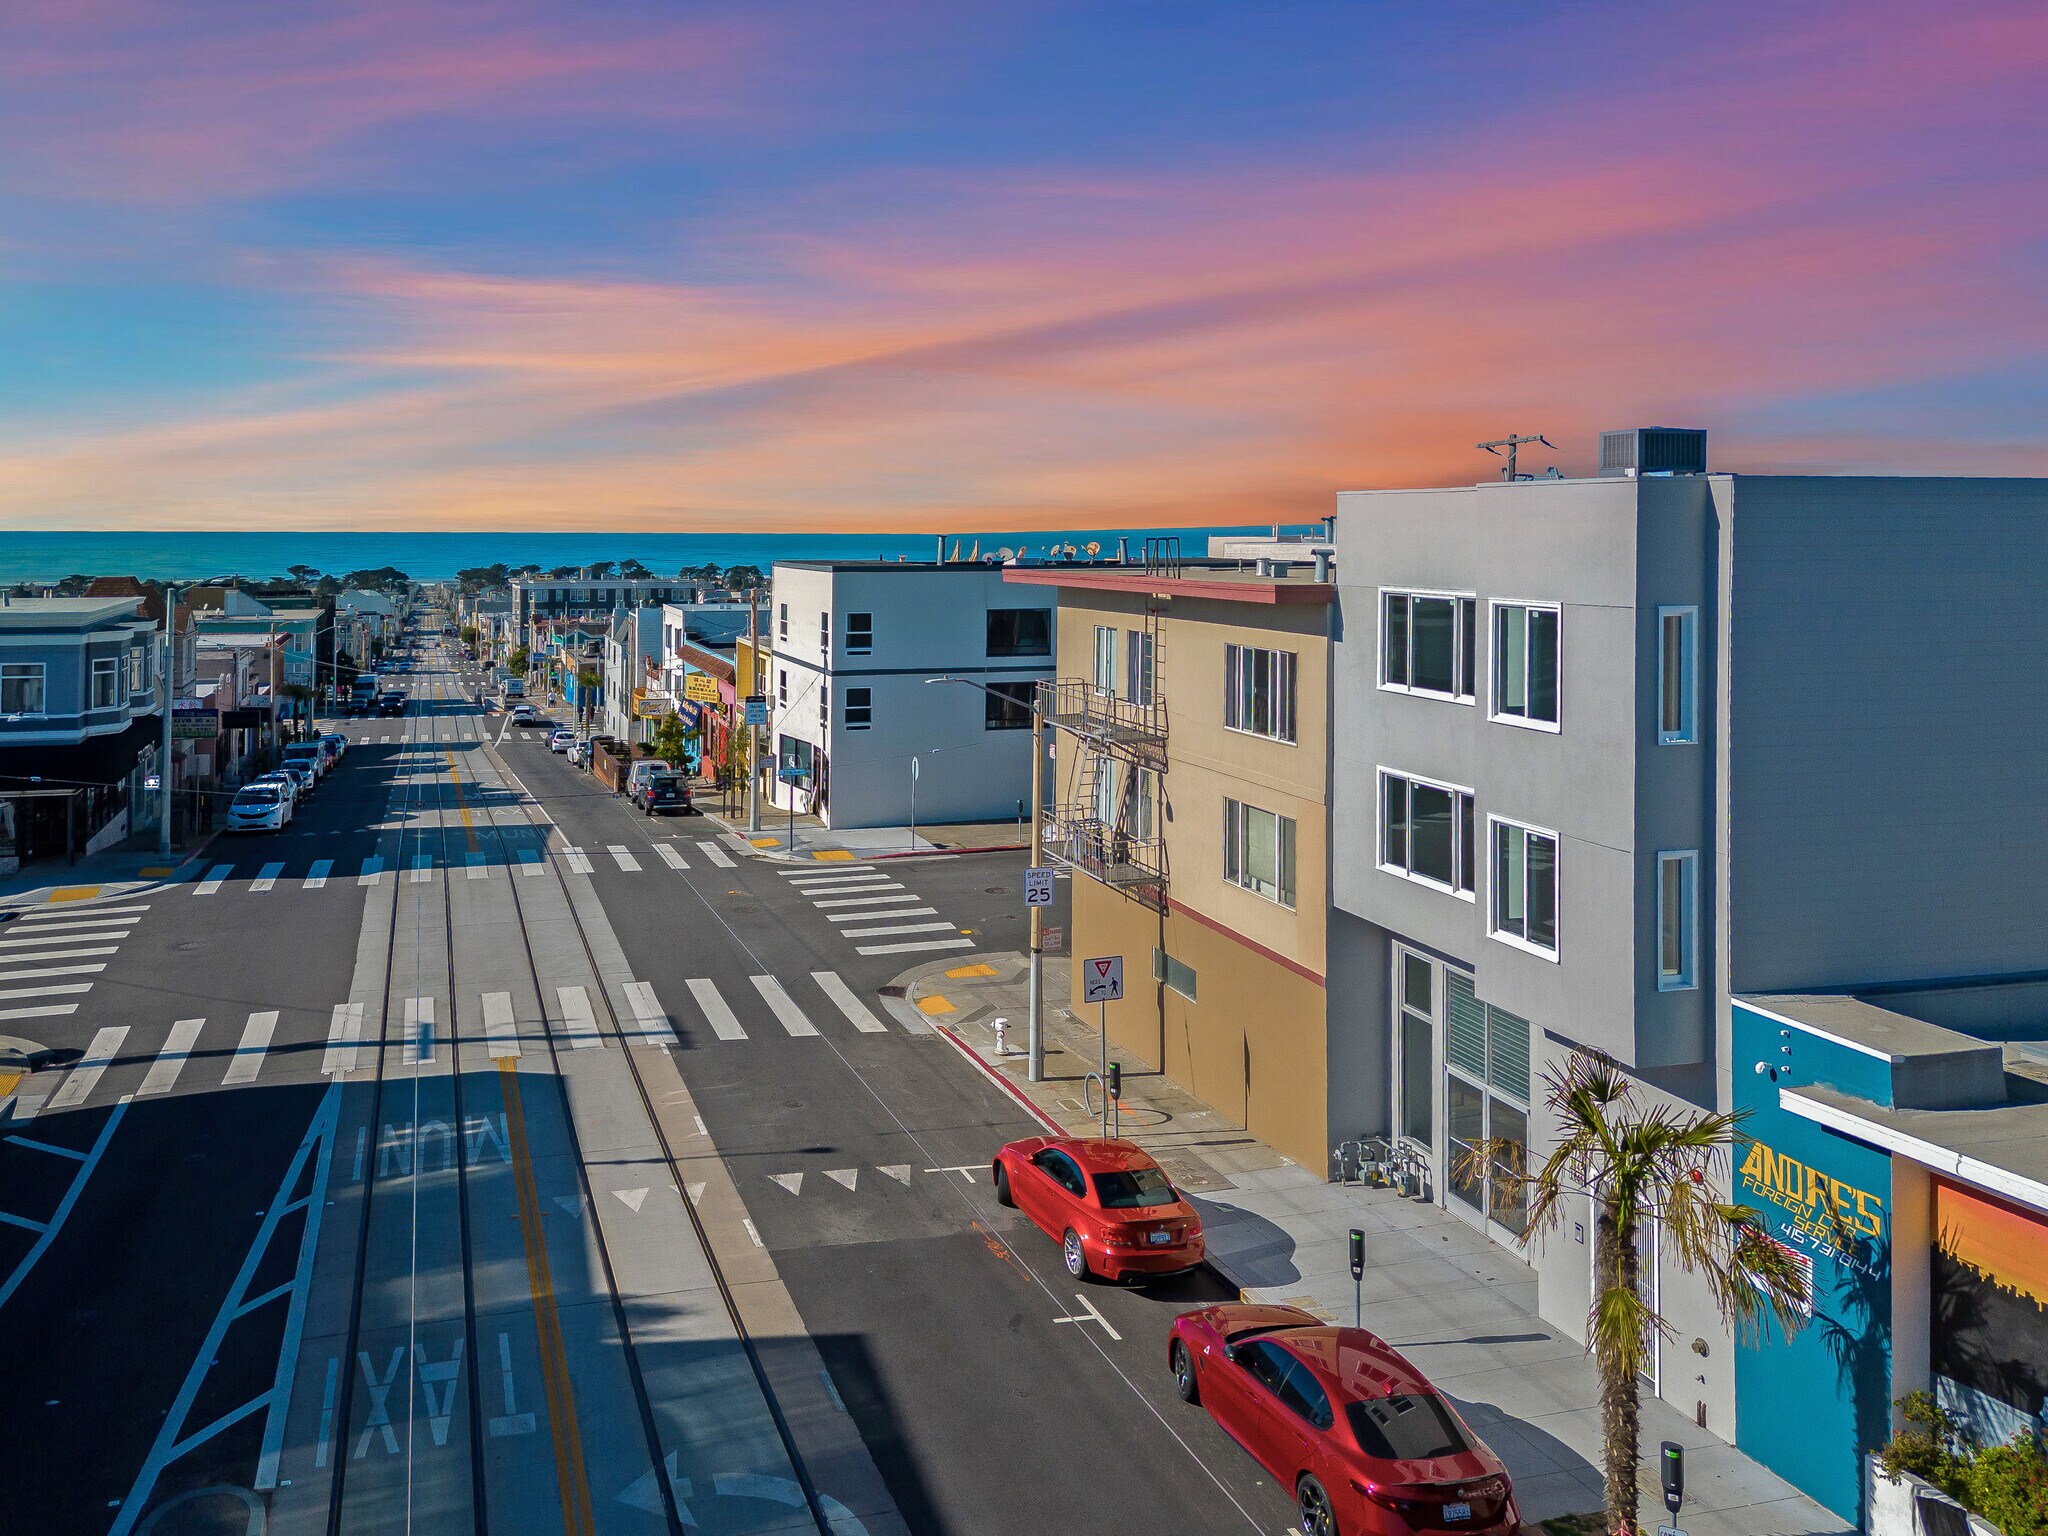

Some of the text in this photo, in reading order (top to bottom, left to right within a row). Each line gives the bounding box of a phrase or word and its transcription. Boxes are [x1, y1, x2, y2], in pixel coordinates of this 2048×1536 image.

[471, 808, 534, 817] TAXI
[475, 828, 549, 839] MUNI
[1027, 871, 1051, 879] SPEED
[1029, 879, 1049, 887] LIMIT
[1027, 888, 1051, 902] 25
[352, 1112, 513, 1181] MUNI
[1739, 1141, 1883, 1238] ANDRE'S
[1742, 1176, 1813, 1219] FOREIGN
[1792, 1215, 1861, 1258] SERVICE
[1818, 1214, 1857, 1240] CAR
[315, 1332, 536, 1468] TAXI
